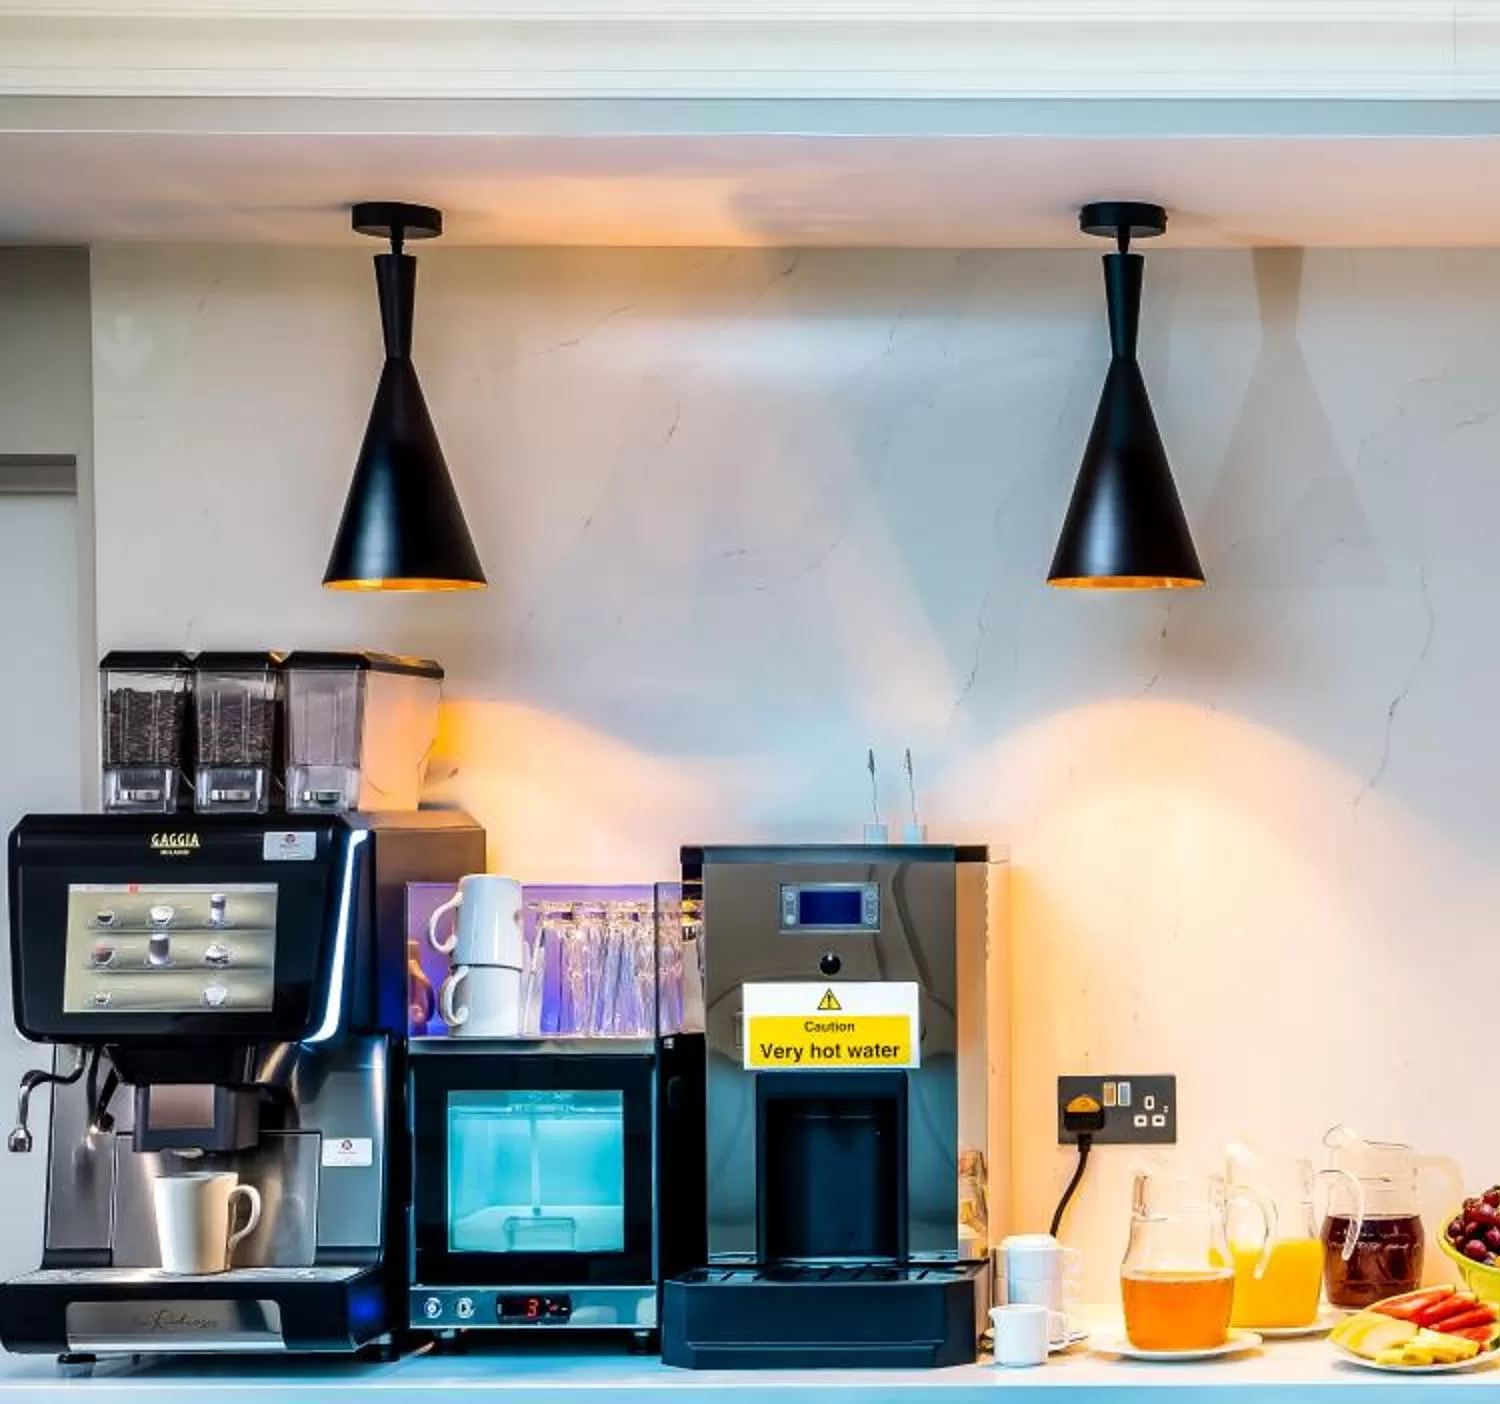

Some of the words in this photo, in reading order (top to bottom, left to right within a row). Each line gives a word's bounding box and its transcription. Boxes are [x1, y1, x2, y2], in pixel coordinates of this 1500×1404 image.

[151, 833, 200, 847] GAGGIA
[804, 1021, 855, 1033] Caution
[760, 1043, 803, 1062] Very
[811, 1043, 842, 1059] hot
[848, 1044, 900, 1059] water
[527, 1298, 540, 1317] 3
